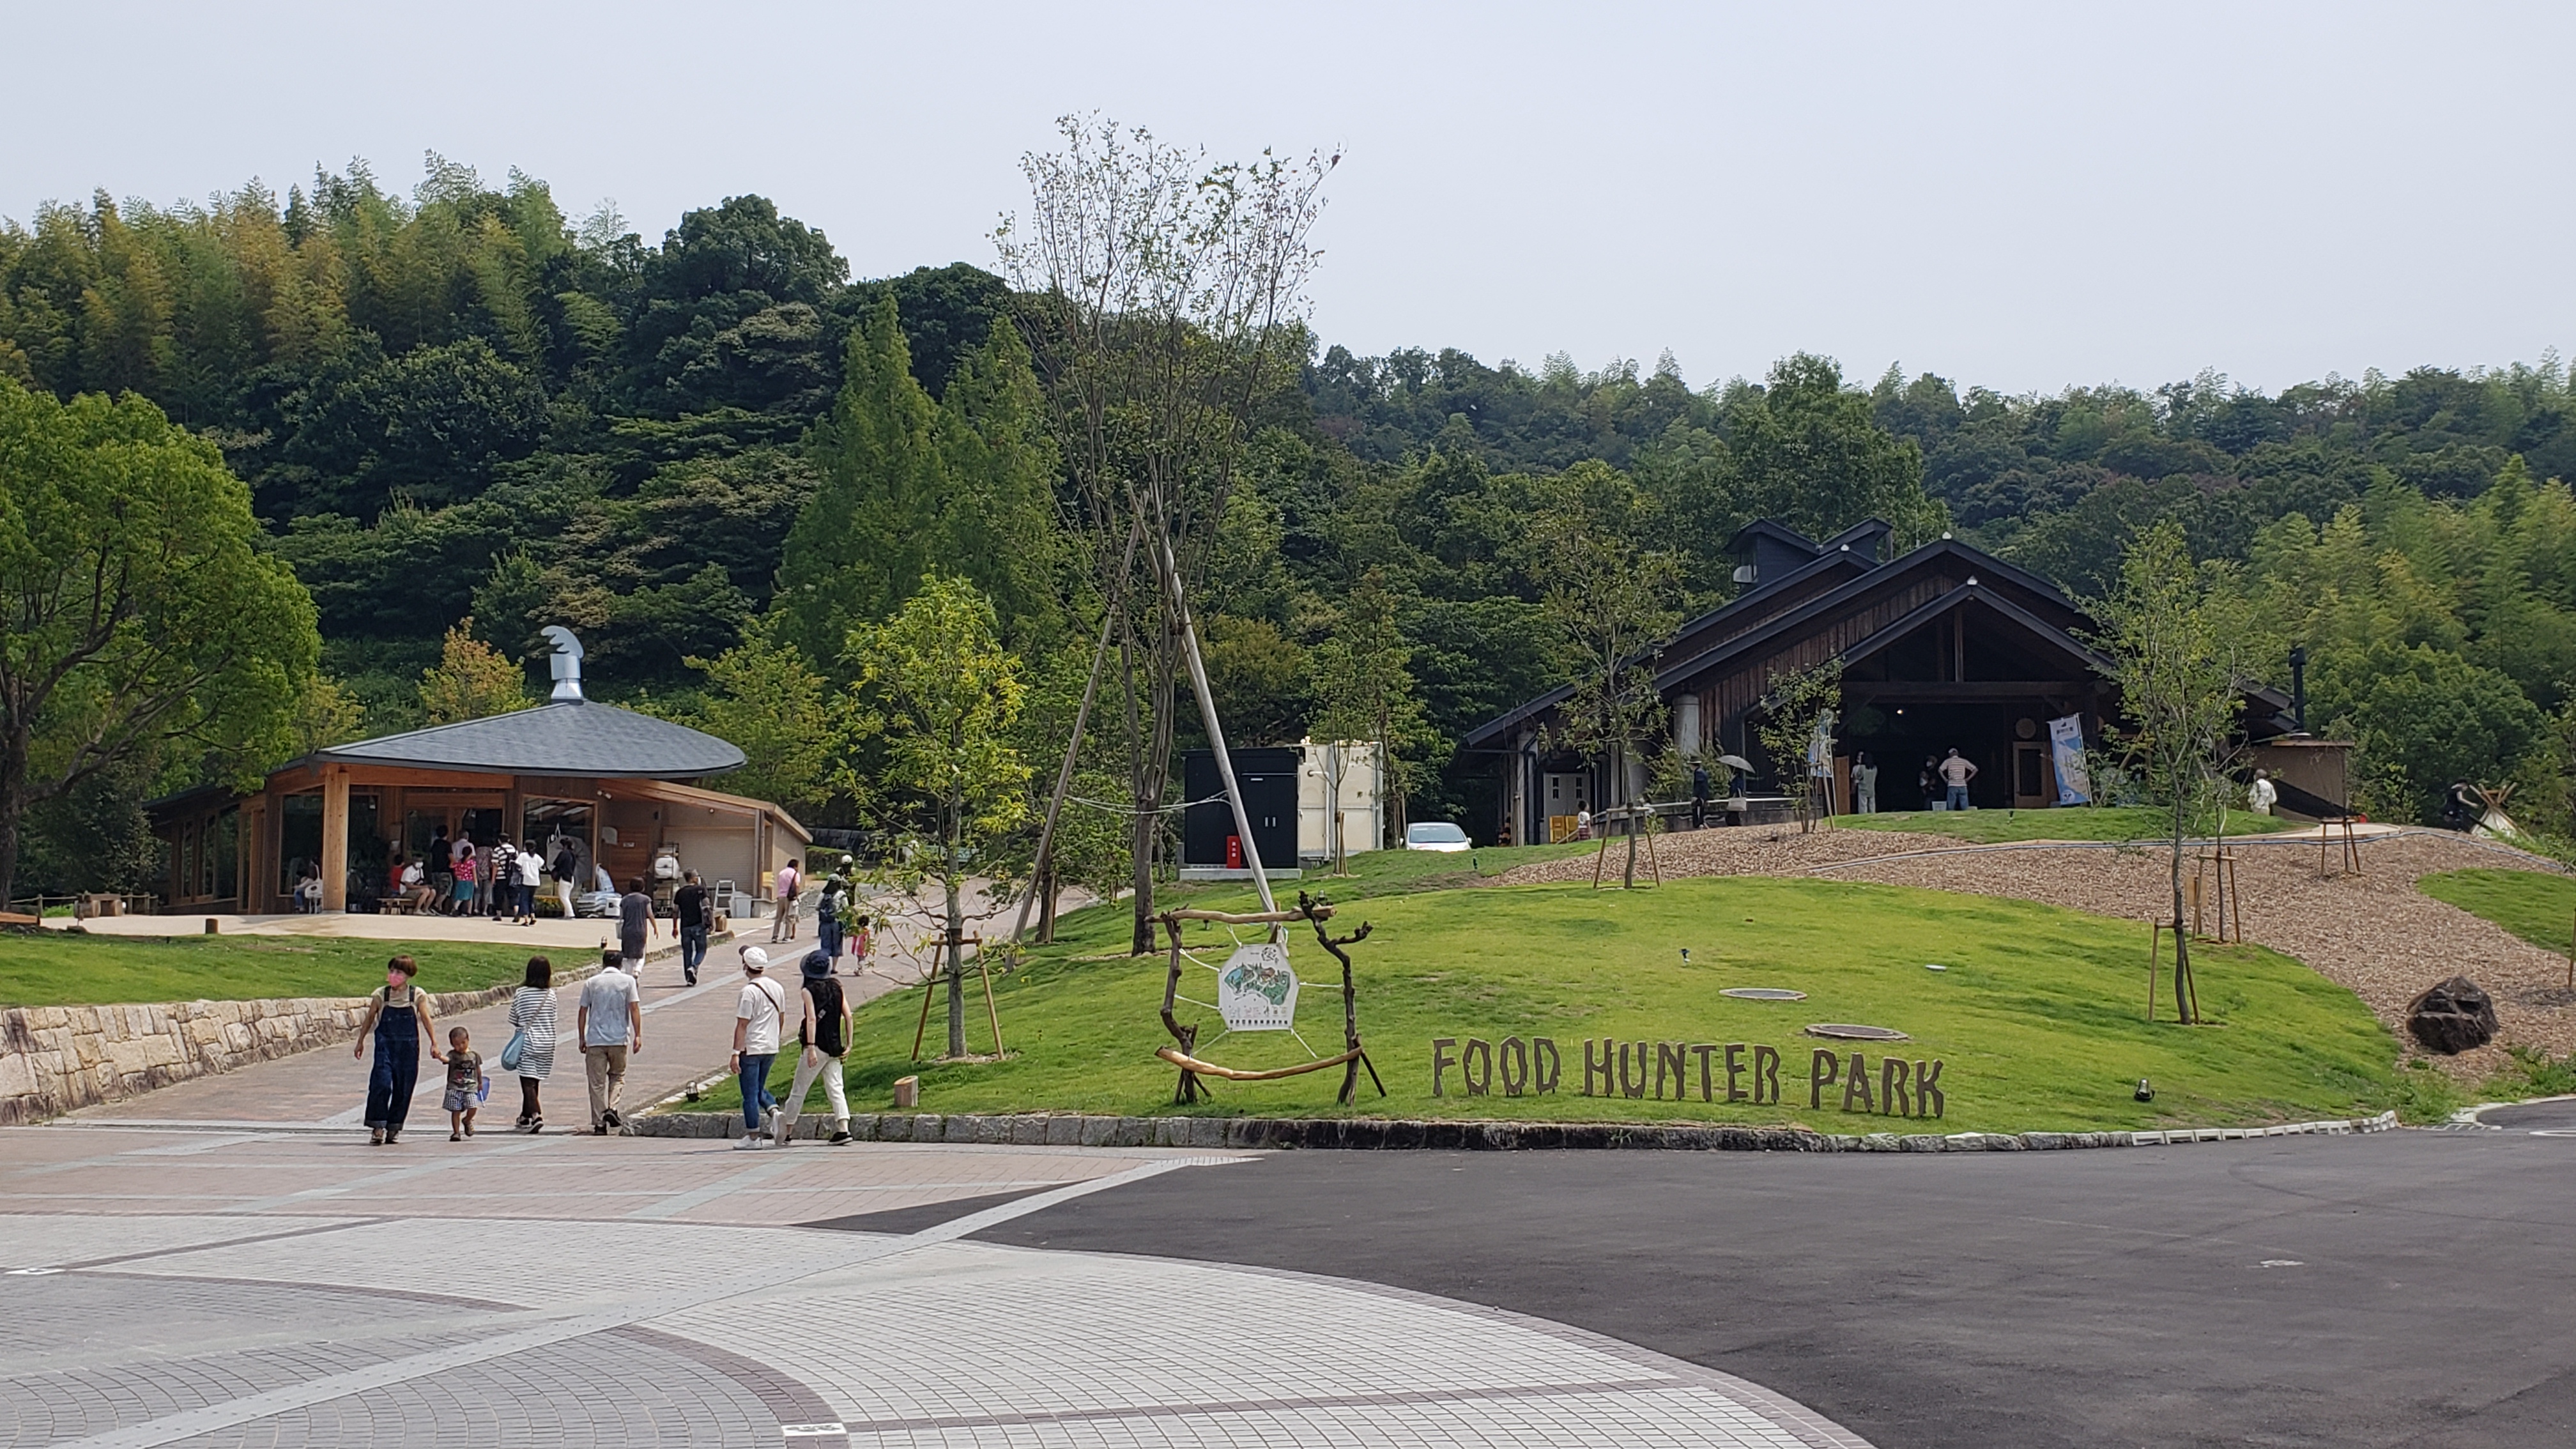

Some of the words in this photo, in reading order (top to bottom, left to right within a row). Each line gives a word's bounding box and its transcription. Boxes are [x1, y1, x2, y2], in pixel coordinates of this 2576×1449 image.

[1432, 1036, 1561, 1095] FOOD
[1584, 1038, 1781, 1102] HUNTER
[1811, 1048, 1943, 1117] PARK
